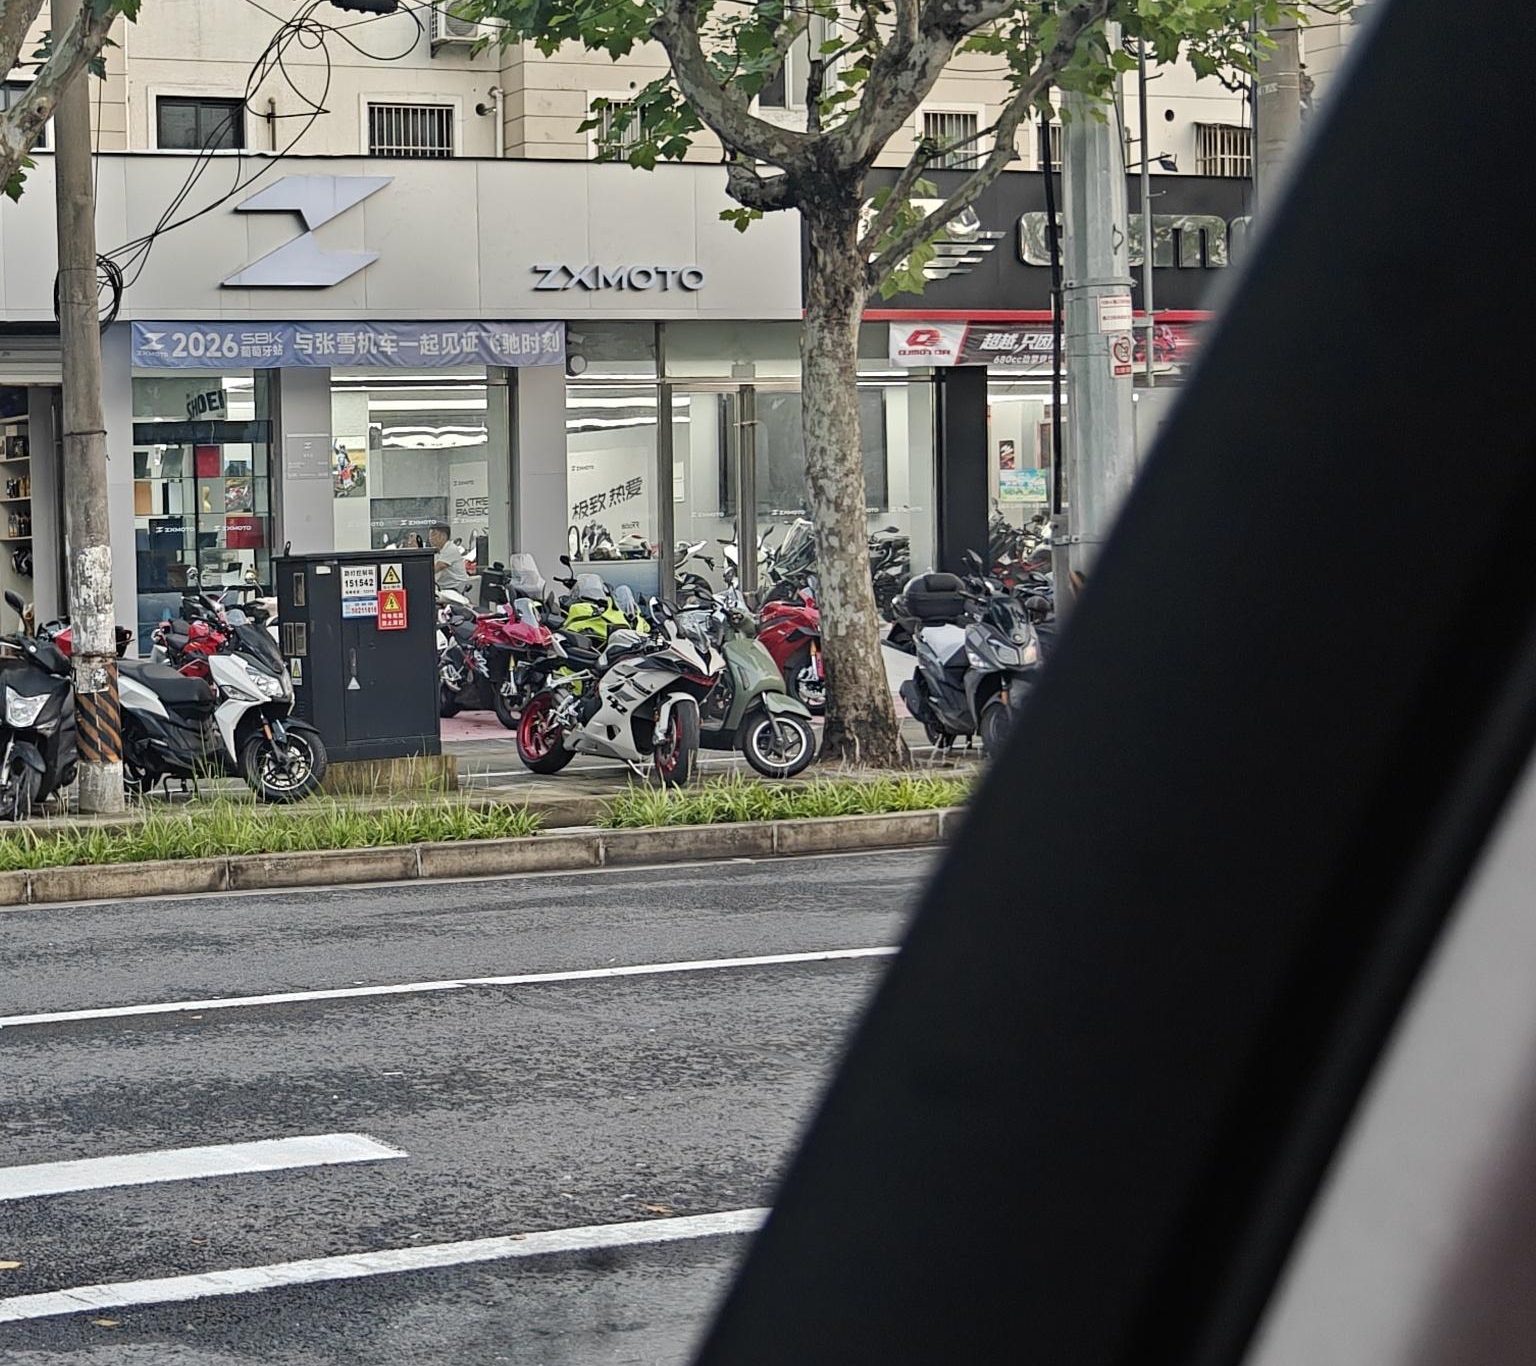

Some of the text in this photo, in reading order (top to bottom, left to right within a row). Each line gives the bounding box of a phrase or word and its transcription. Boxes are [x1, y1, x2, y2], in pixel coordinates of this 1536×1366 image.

[532, 265, 706, 291] ZXMOTO
[172, 331, 239, 358] 2026
[240, 332, 283, 344] SBK
[241, 344, 283, 358] 葡萄牙站
[572, 476, 643, 520] 极致热爱
[345, 578, 374, 588] 151542
